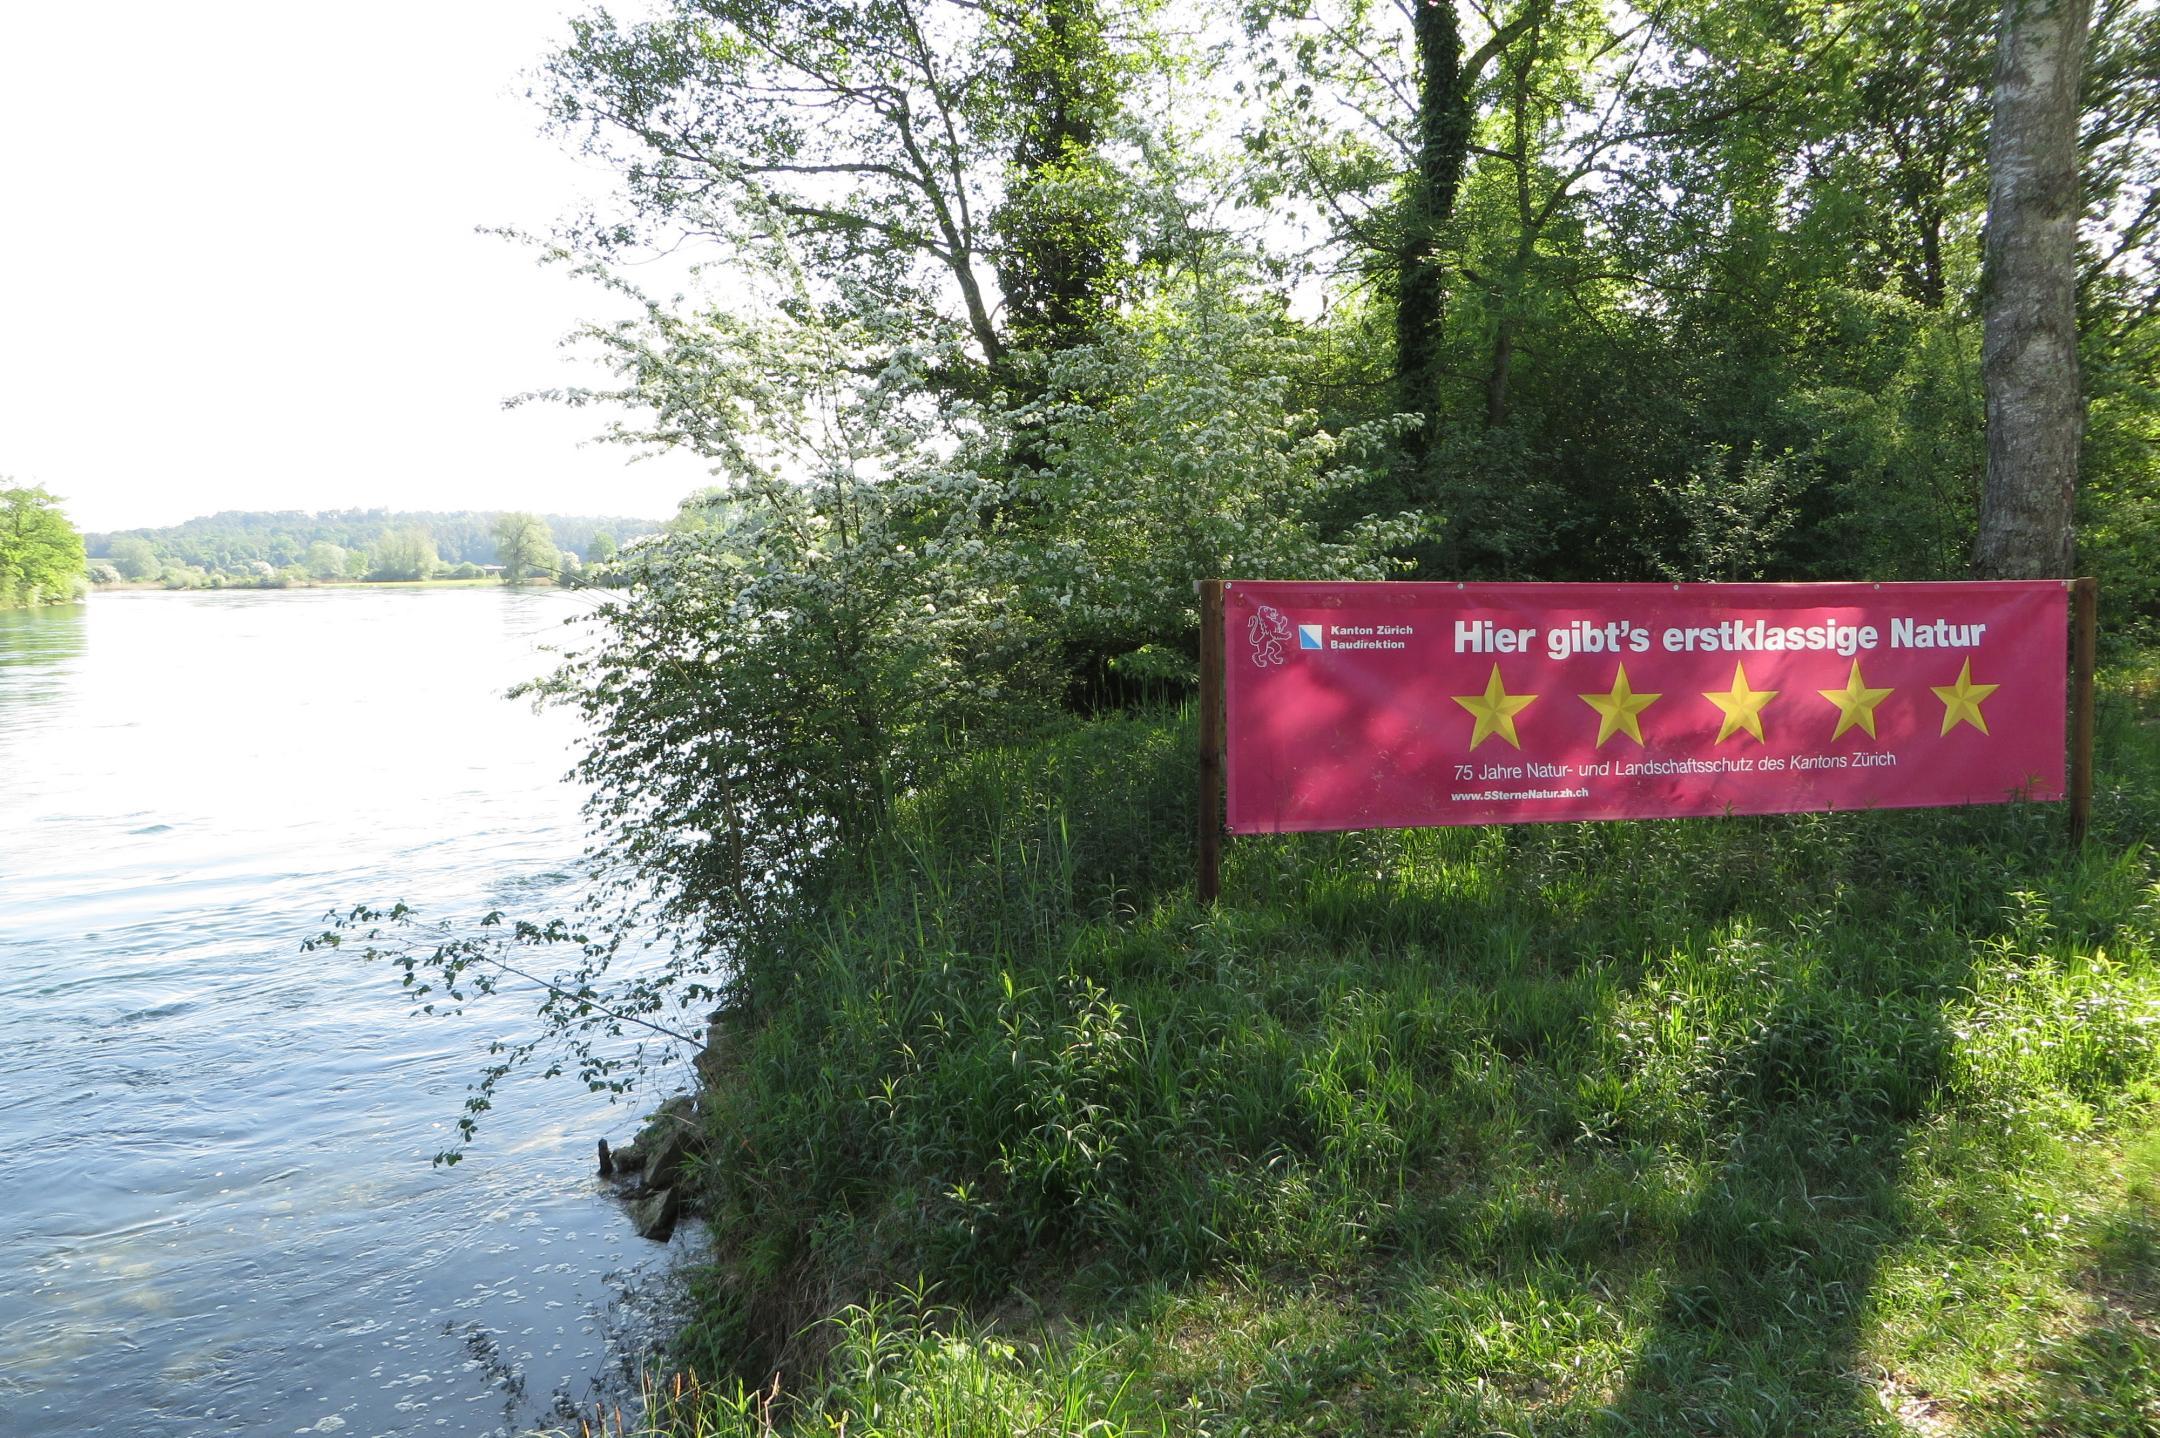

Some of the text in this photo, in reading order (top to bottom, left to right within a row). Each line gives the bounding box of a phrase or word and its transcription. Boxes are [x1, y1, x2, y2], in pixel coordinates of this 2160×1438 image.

[1330, 625, 1413, 636] Kanton Zürich
[1454, 617, 1987, 660] Hier gibt’s erstklassige Natur
[1330, 639, 1405, 649] Baudirektion
[1454, 751, 1897, 781] 75 Jahre Natur- und Landschaftsschutz des Kantons Zürich
[1451, 786, 1589, 802] www.5SterneNatur.zh.ch
